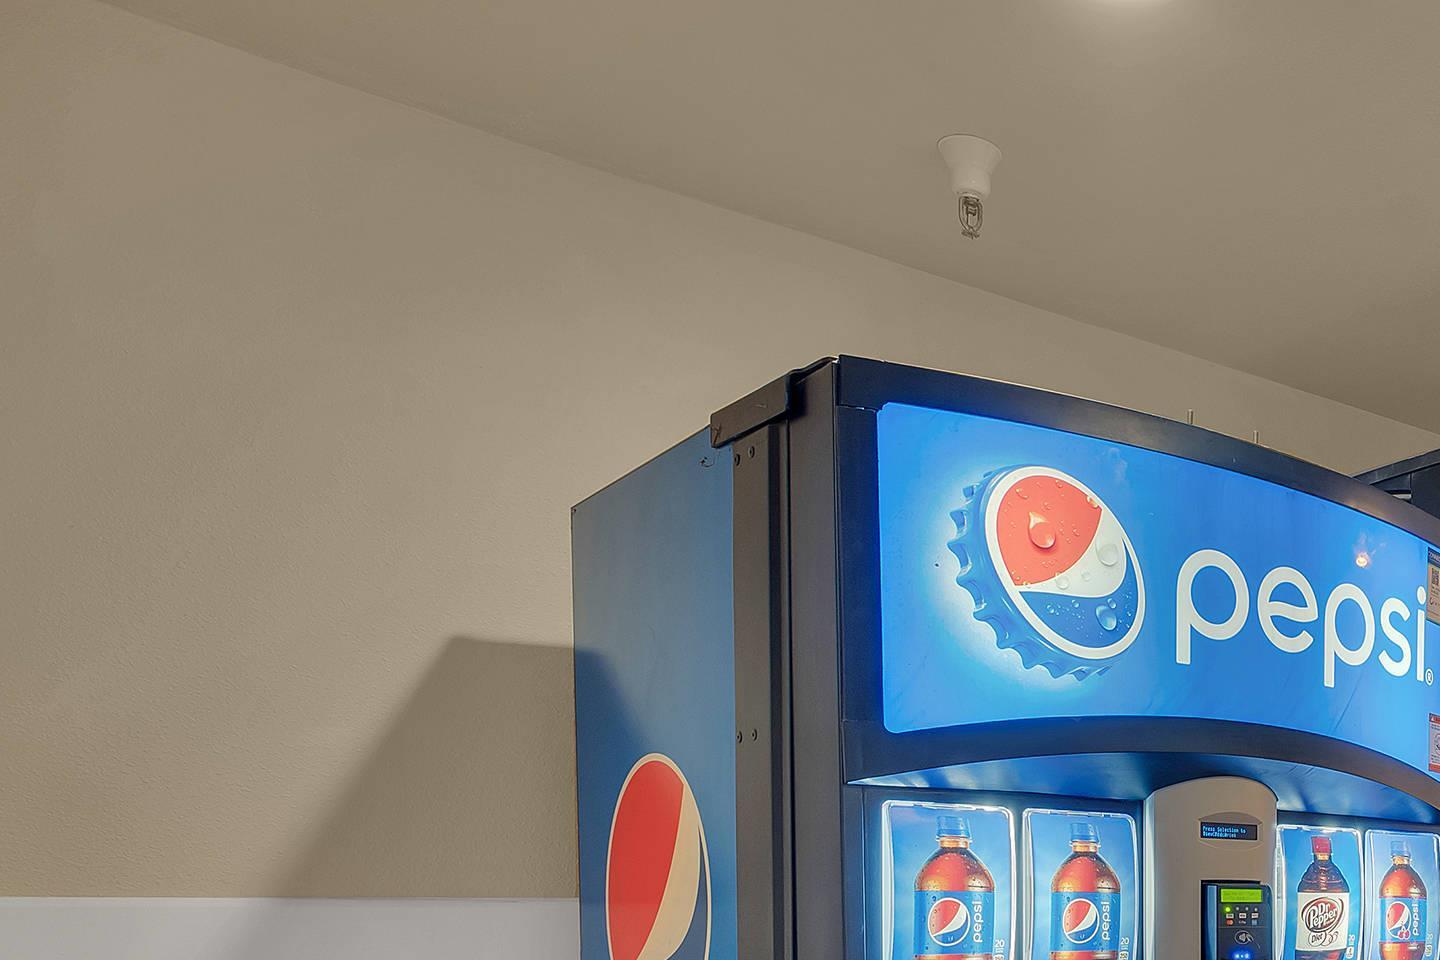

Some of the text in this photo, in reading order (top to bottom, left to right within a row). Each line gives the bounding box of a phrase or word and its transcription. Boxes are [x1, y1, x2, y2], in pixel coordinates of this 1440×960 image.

[1175, 548, 1427, 688] pepsi
[971, 900, 984, 943] pepsi
[1100, 901, 1112, 941] pepsi
[1308, 905, 1338, 929] Pepper
[1317, 902, 1330, 916] Dr
[1411, 903, 1420, 936] pepsi
[994, 939, 1005, 948] 20
[1120, 937, 1130, 945] 20
